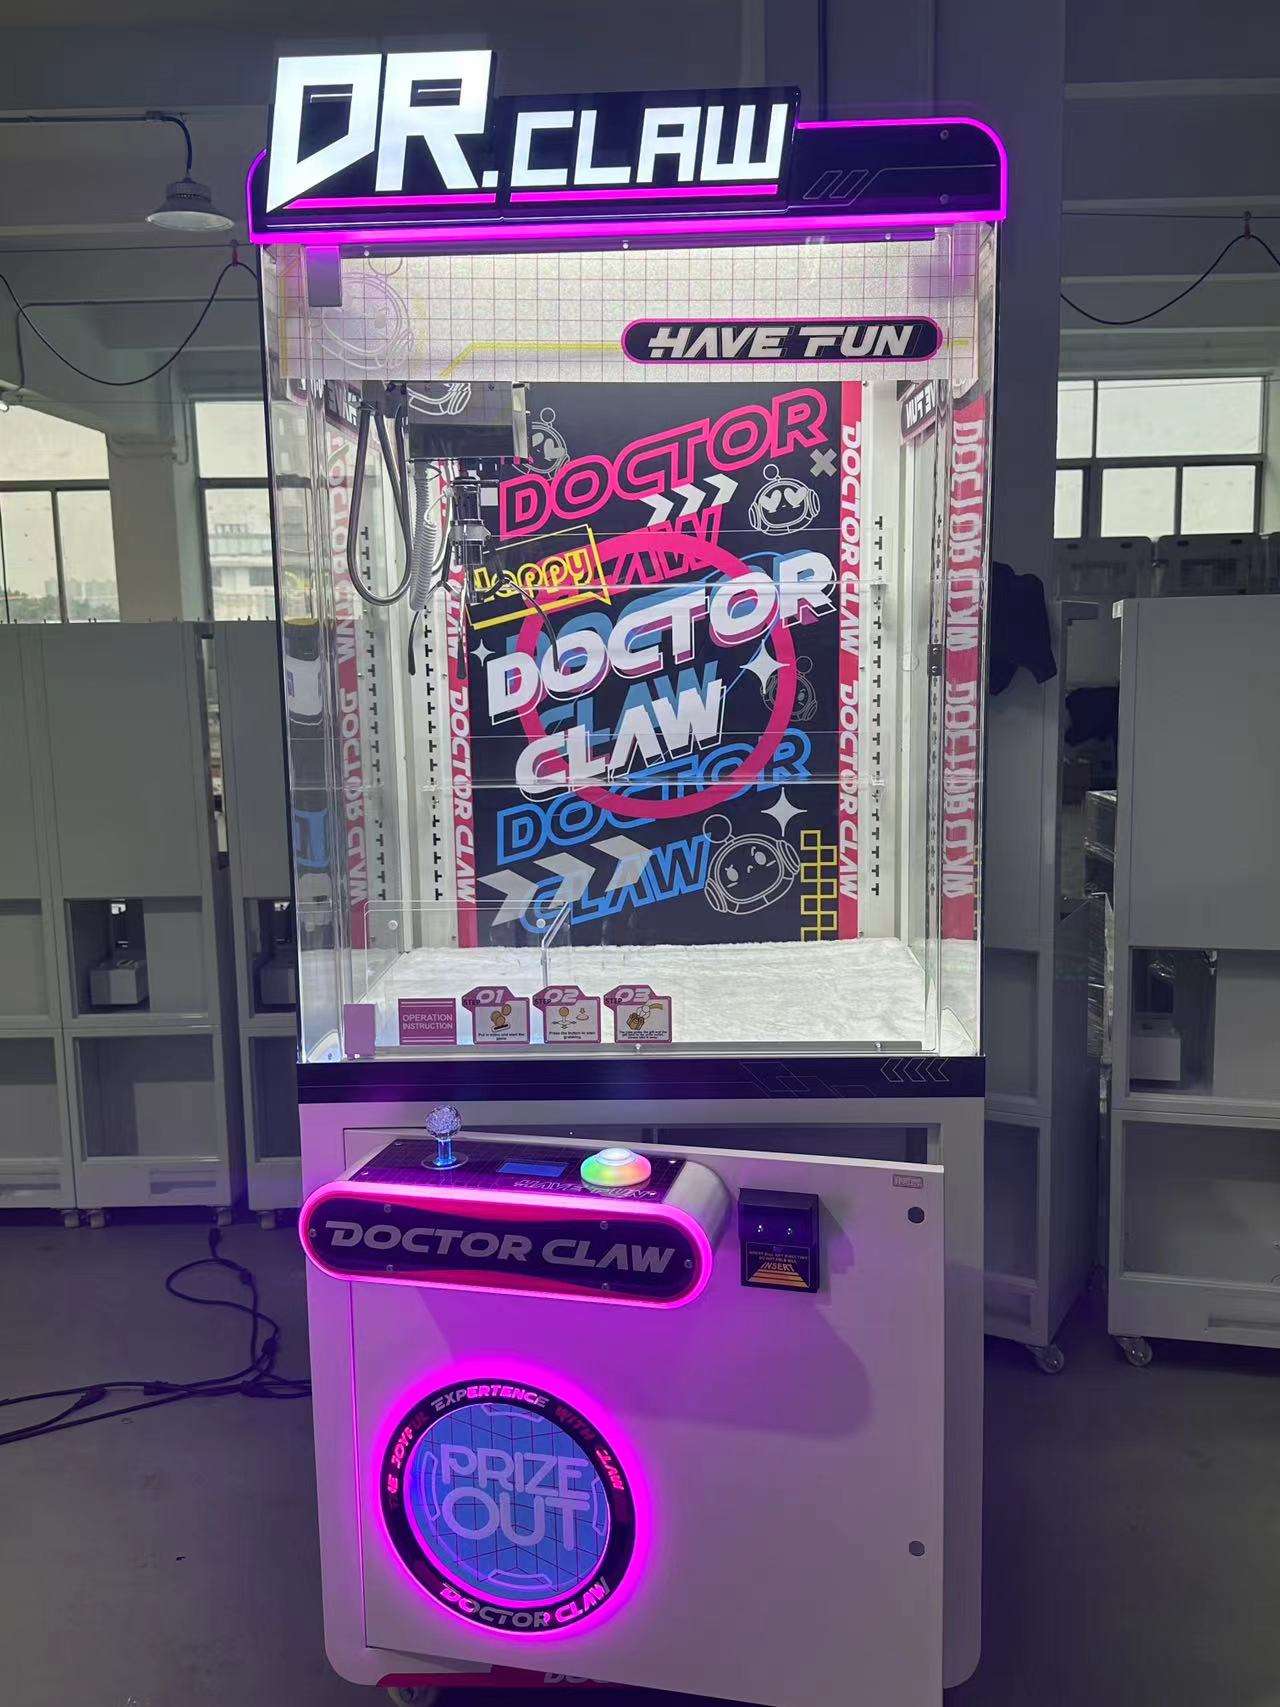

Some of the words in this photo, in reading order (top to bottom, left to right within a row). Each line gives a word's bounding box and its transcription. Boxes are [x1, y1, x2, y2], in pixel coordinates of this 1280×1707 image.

[266, 50, 498, 213] DR.
[510, 104, 788, 187] CLAW
[648, 327, 790, 358] HAVE
[798, 325, 914, 356] FUN
[500, 388, 829, 540] DOCTOR
[841, 421, 861, 566] DOCTOR
[487, 551, 836, 724] DOCTOR
[840, 570, 861, 657] CLAW
[450, 686, 473, 821] DOCTOR
[515, 678, 727, 802] CLAW
[839, 680, 859, 815] DOCTOR
[455, 825, 476, 904] CLAW
[839, 819, 858, 900] CLAW
[402, 1013, 453, 1022] OPERATION
[402, 1022, 453, 1031] INSTRUCTION
[476, 989, 504, 1004] 01
[543, 989, 580, 1003] 02
[615, 988, 650, 1003] 03
[325, 1220, 532, 1262] DOCTOR
[542, 1240, 675, 1273] CLAW
[760, 1262, 795, 1273] INSERT
[440, 1443, 591, 1501] PRIZE
[441, 1486, 591, 1551] OUT
[439, 1581, 551, 1627] DOCTOR
[554, 1576, 611, 1623] CLAW
